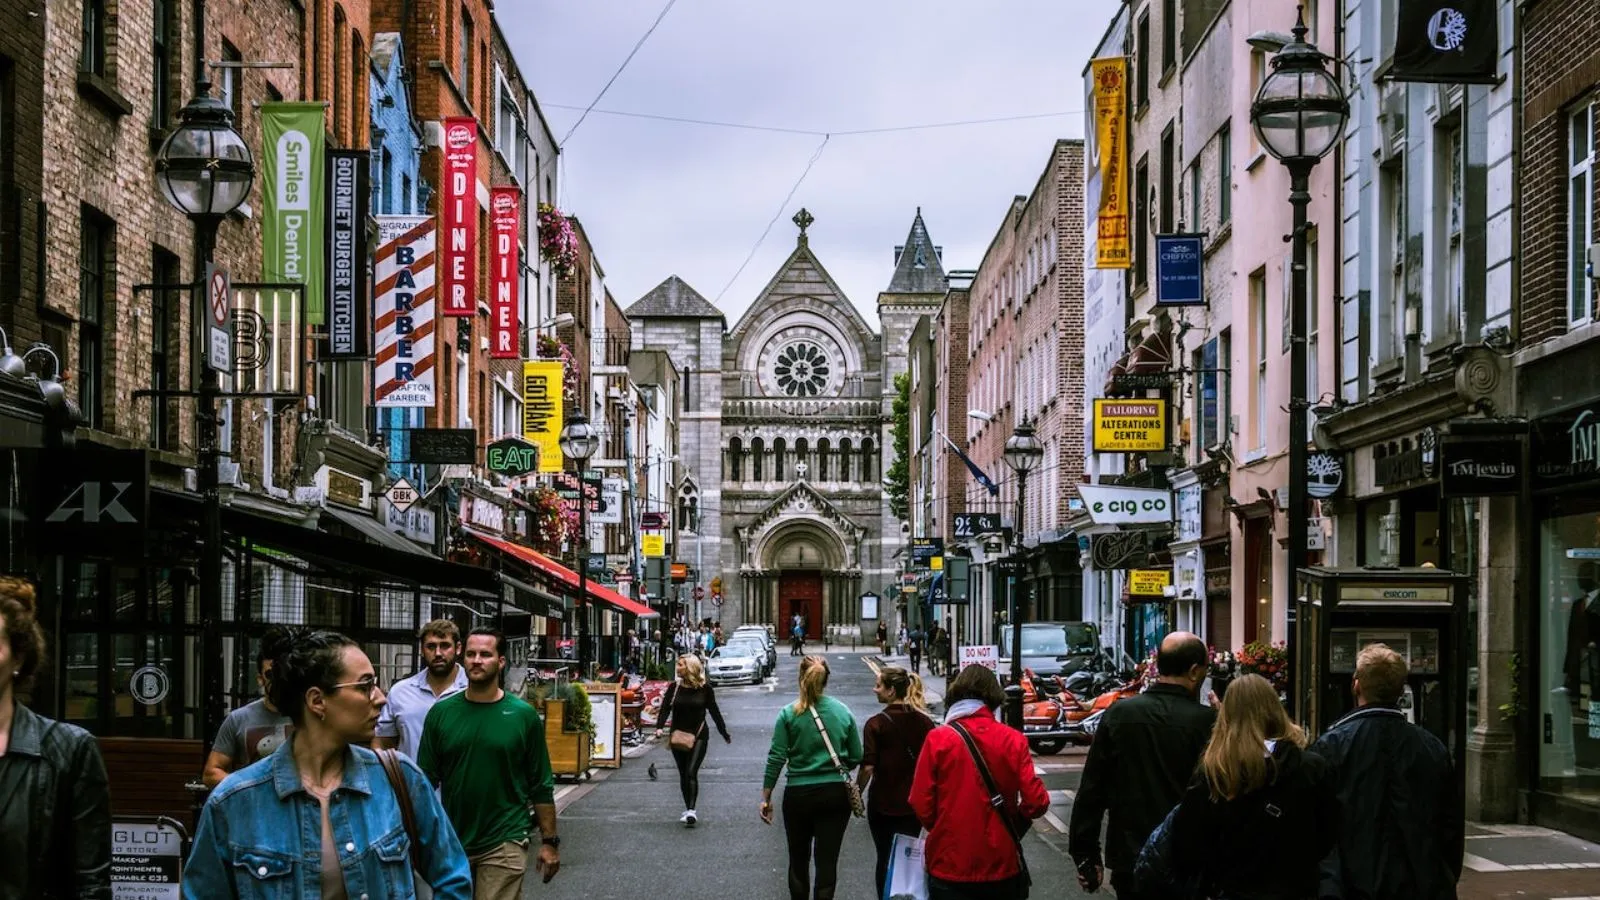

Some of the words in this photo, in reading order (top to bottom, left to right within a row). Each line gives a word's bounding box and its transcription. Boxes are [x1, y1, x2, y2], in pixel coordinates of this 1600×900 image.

[286, 141, 303, 203] Smiles
[336, 157, 352, 227] GOURMET
[285, 215, 302, 280] Dental
[335, 230, 351, 286] BURGER
[452, 172, 466, 308] DINER
[395, 246, 415, 381] BARBER
[498, 234, 511, 351] DINER
[335, 290, 351, 353] KITCHEN
[526, 375, 555, 433] GOTHAM
[1101, 420, 1160, 429] ALTERATIONS
[1107, 406, 1156, 415] TAILORING
[490, 446, 535, 470] EAT
[1113, 431, 1148, 440] CENTRE
[45, 482, 138, 523] AK
[393, 491, 412, 500] GBK
[1093, 501, 1104, 513] e
[1108, 500, 1137, 515] cig
[1142, 499, 1166, 511] co
[966, 648, 975, 657] DO
[977, 647, 991, 657] NOT
